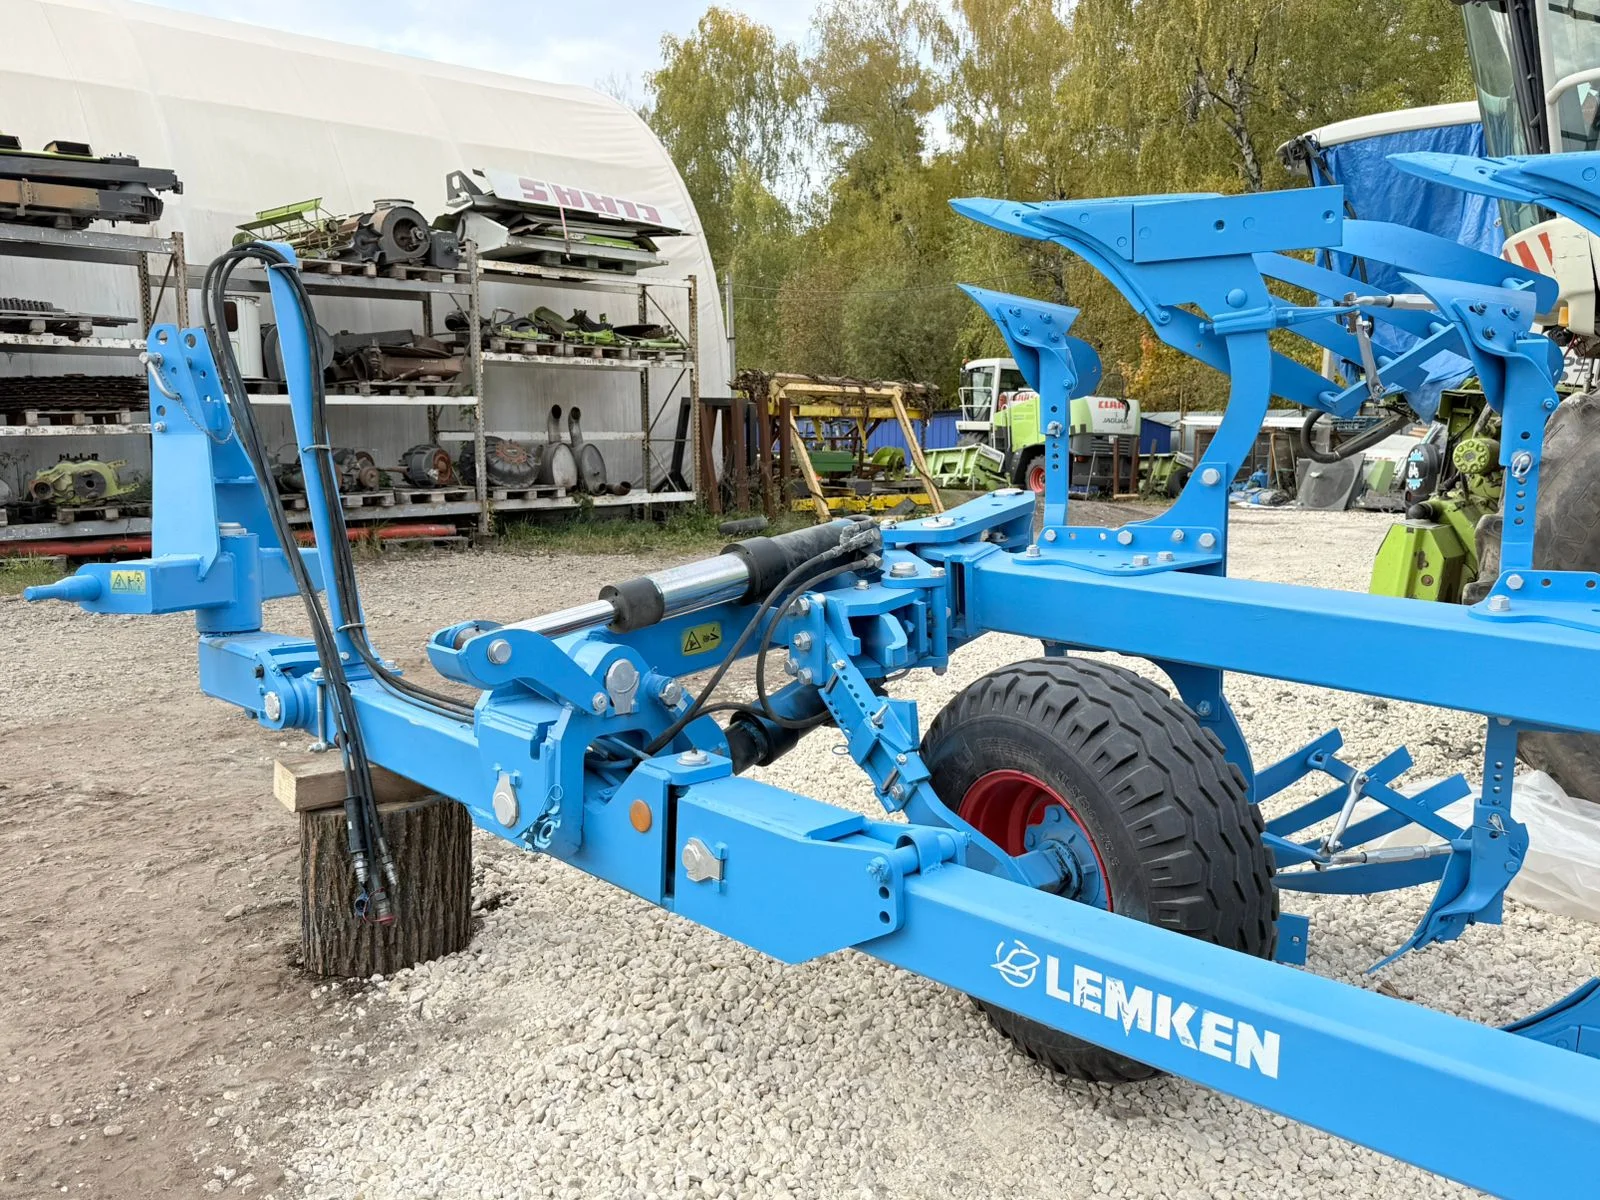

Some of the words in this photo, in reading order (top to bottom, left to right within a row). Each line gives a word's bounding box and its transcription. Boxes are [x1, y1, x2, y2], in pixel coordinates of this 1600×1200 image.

[518, 177, 662, 224] CLAAS
[1098, 400, 1128, 409] CLAA
[1045, 954, 1281, 1080] LEMKEN
